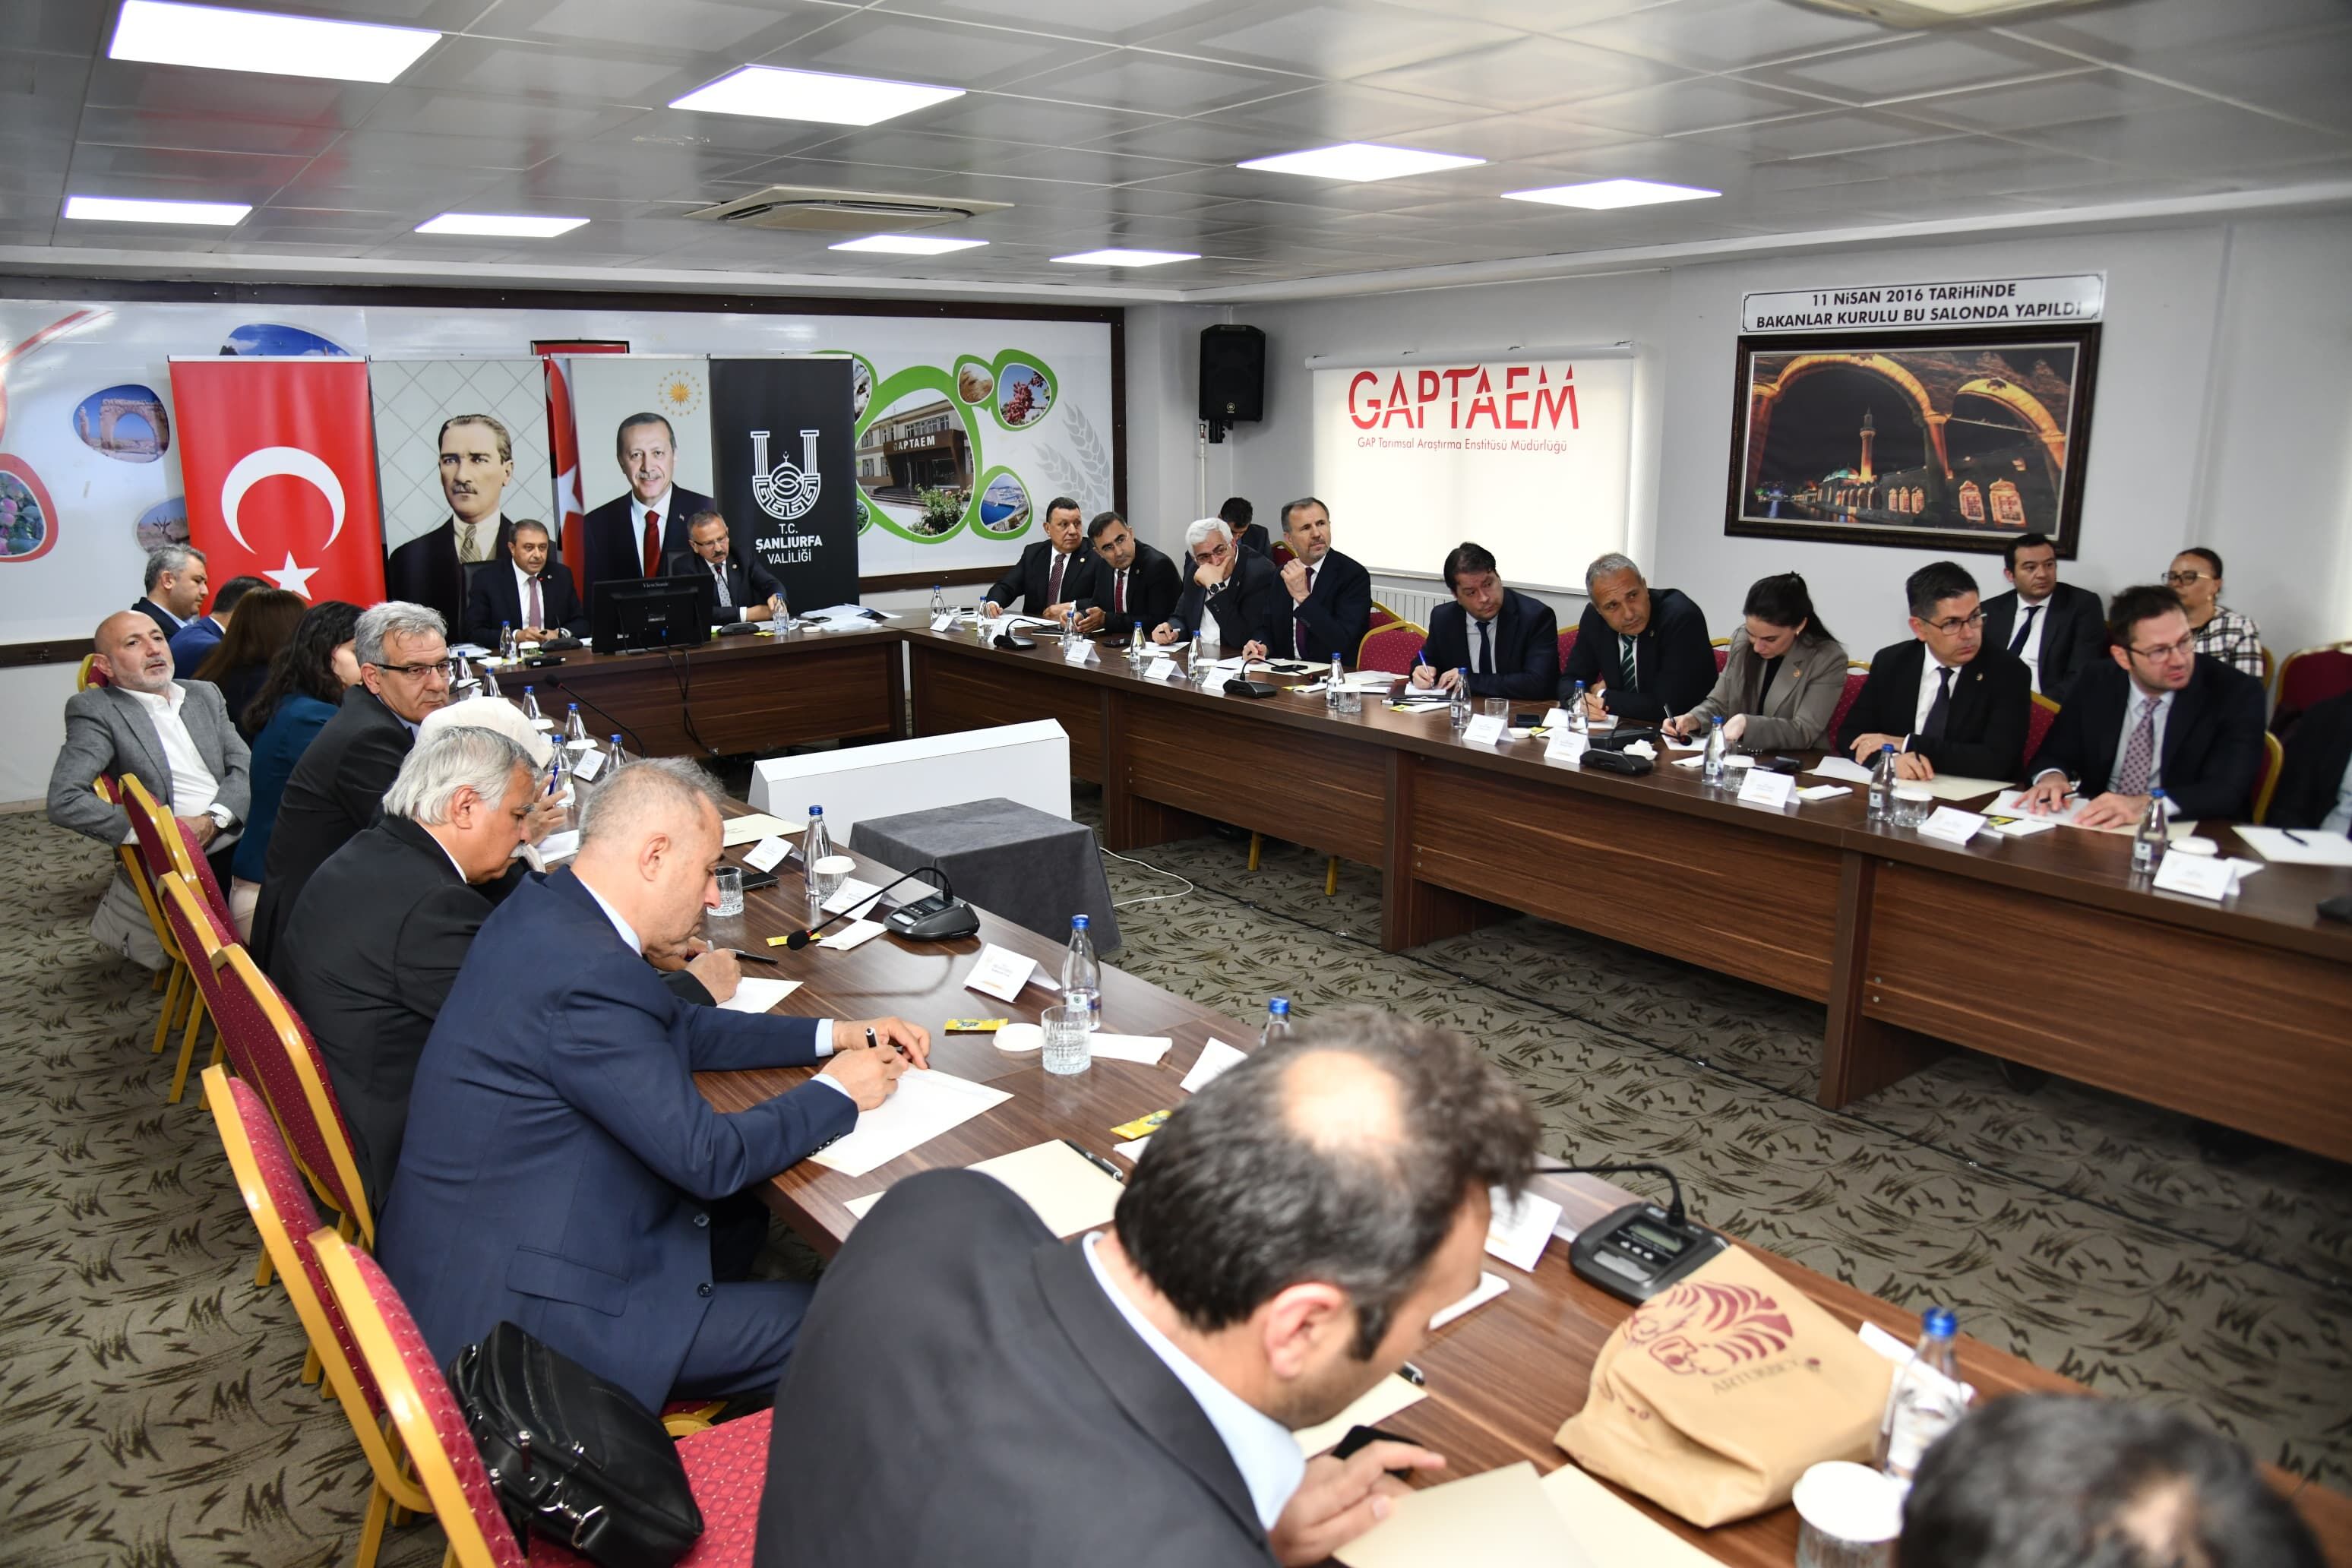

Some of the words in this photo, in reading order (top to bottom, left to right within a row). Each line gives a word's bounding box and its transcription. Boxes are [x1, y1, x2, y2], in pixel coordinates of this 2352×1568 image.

[1813, 294, 1827, 306] 11
[1886, 289, 1924, 302] 2016
[1756, 313, 1832, 328] BAKANLAR
[1837, 309, 1898, 324] KURULU
[1903, 308, 1925, 321] BU
[1930, 304, 2009, 321] SALONDA
[1348, 363, 1579, 431] GAPTAEM
[1358, 437, 1376, 448] GAP
[1379, 438, 1415, 449] Tarımsal
[1417, 438, 1462, 451] Araştırma
[1465, 438, 1507, 450] Enstitüsü
[1510, 439, 1567, 454] Müdürlüğü
[778, 523, 798, 535] T.C.
[755, 535, 823, 553] ŞANLIURFA
[767, 548, 811, 564] VALİLİĞİ
